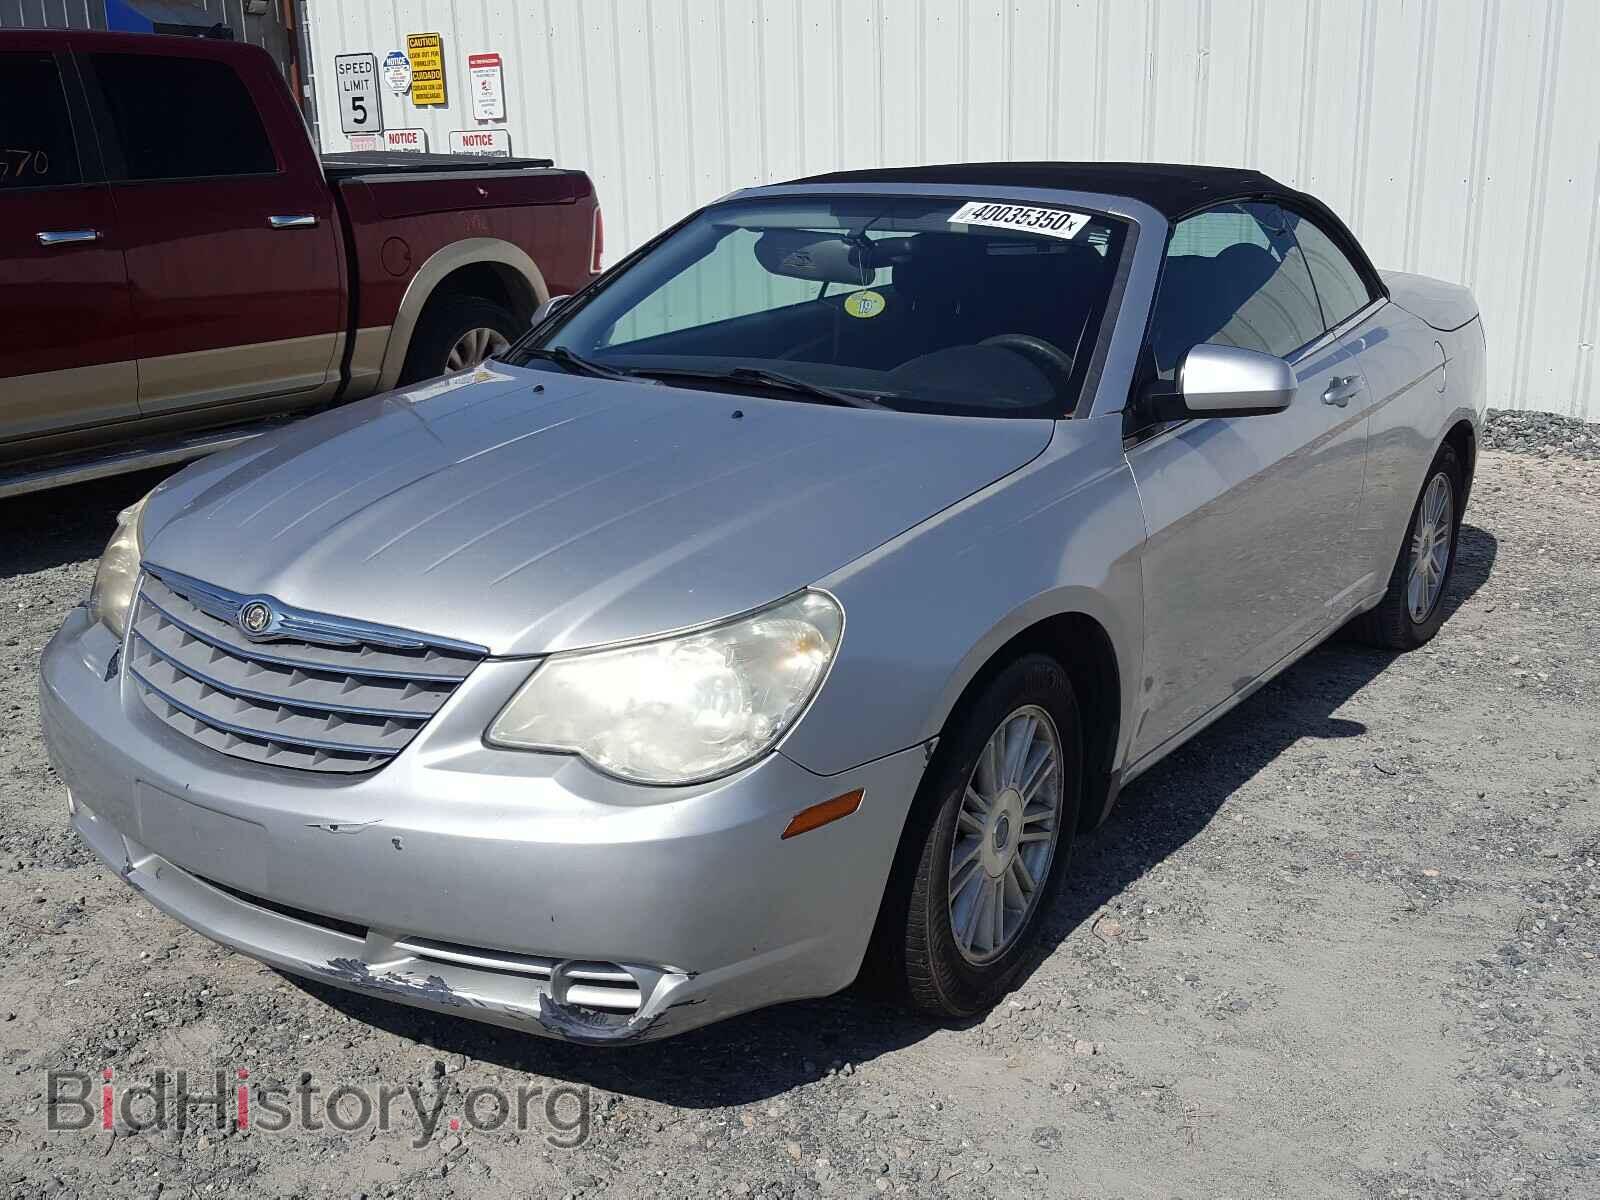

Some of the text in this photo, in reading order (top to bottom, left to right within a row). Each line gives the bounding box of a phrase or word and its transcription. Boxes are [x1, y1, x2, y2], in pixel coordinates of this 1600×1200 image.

[409, 36, 437, 48] CAUTION
[386, 57, 407, 65] NOTICE
[338, 62, 372, 74] SPEED
[412, 70, 441, 81] CUIDADO
[344, 80, 370, 92] LIMIT
[351, 97, 367, 124] 5
[388, 132, 418, 145] NOTICE
[462, 134, 493, 147] NOTICE
